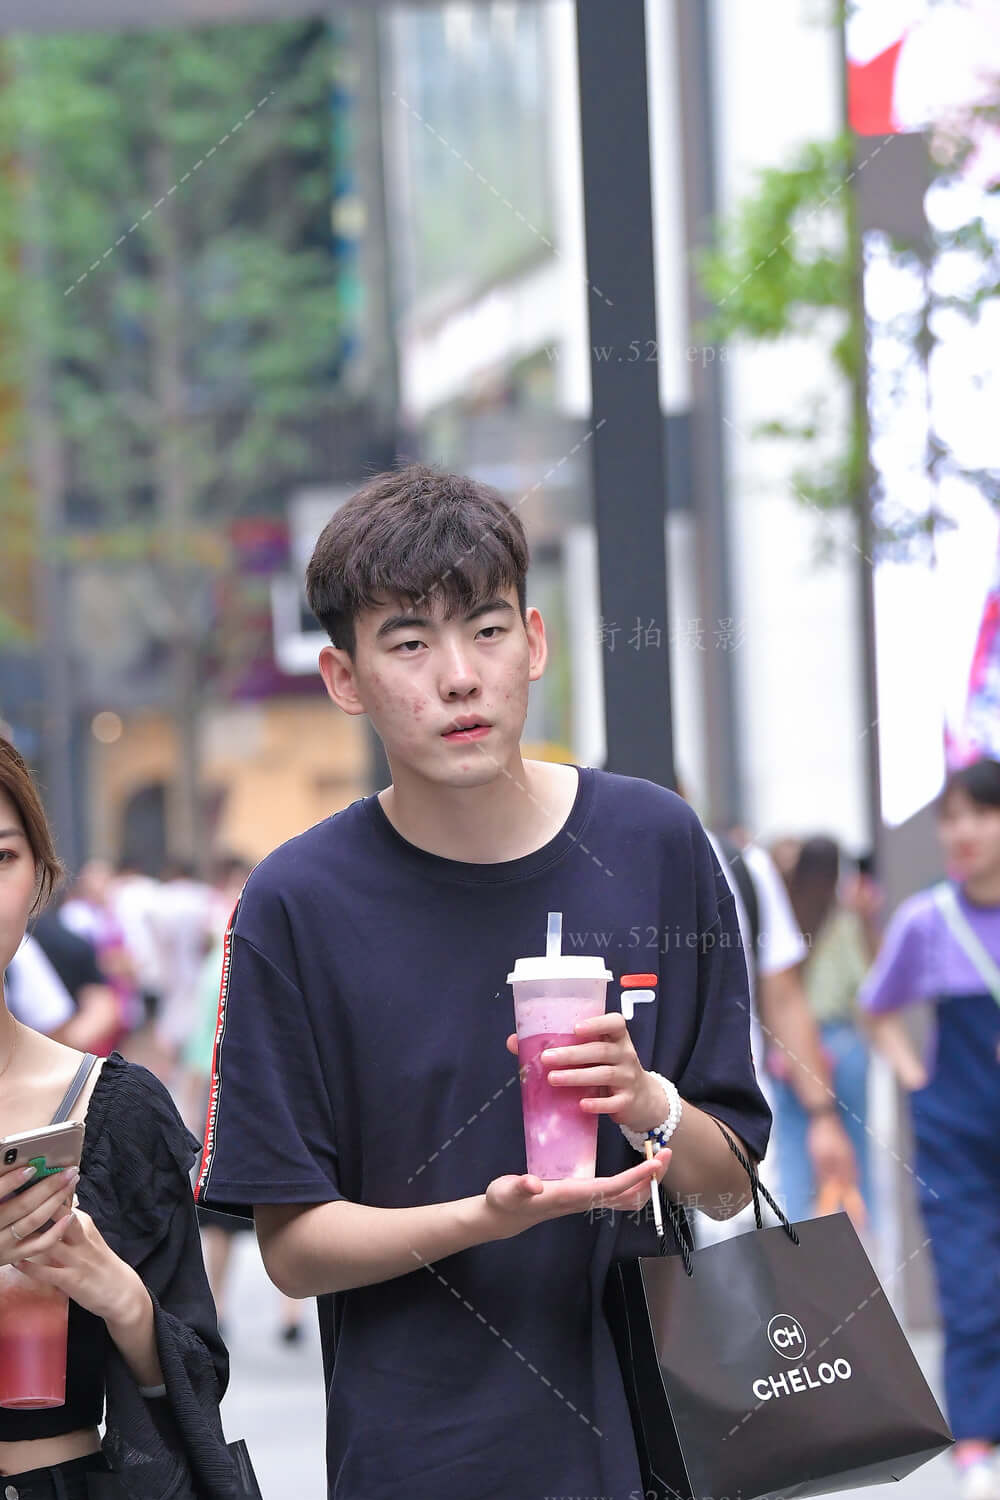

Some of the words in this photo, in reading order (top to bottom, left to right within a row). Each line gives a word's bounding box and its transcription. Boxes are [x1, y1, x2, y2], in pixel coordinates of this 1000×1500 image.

[207, 1072, 219, 1151] ORIGINALE
[773, 1325, 803, 1348] CH
[753, 1358, 852, 1401] CHELOO
